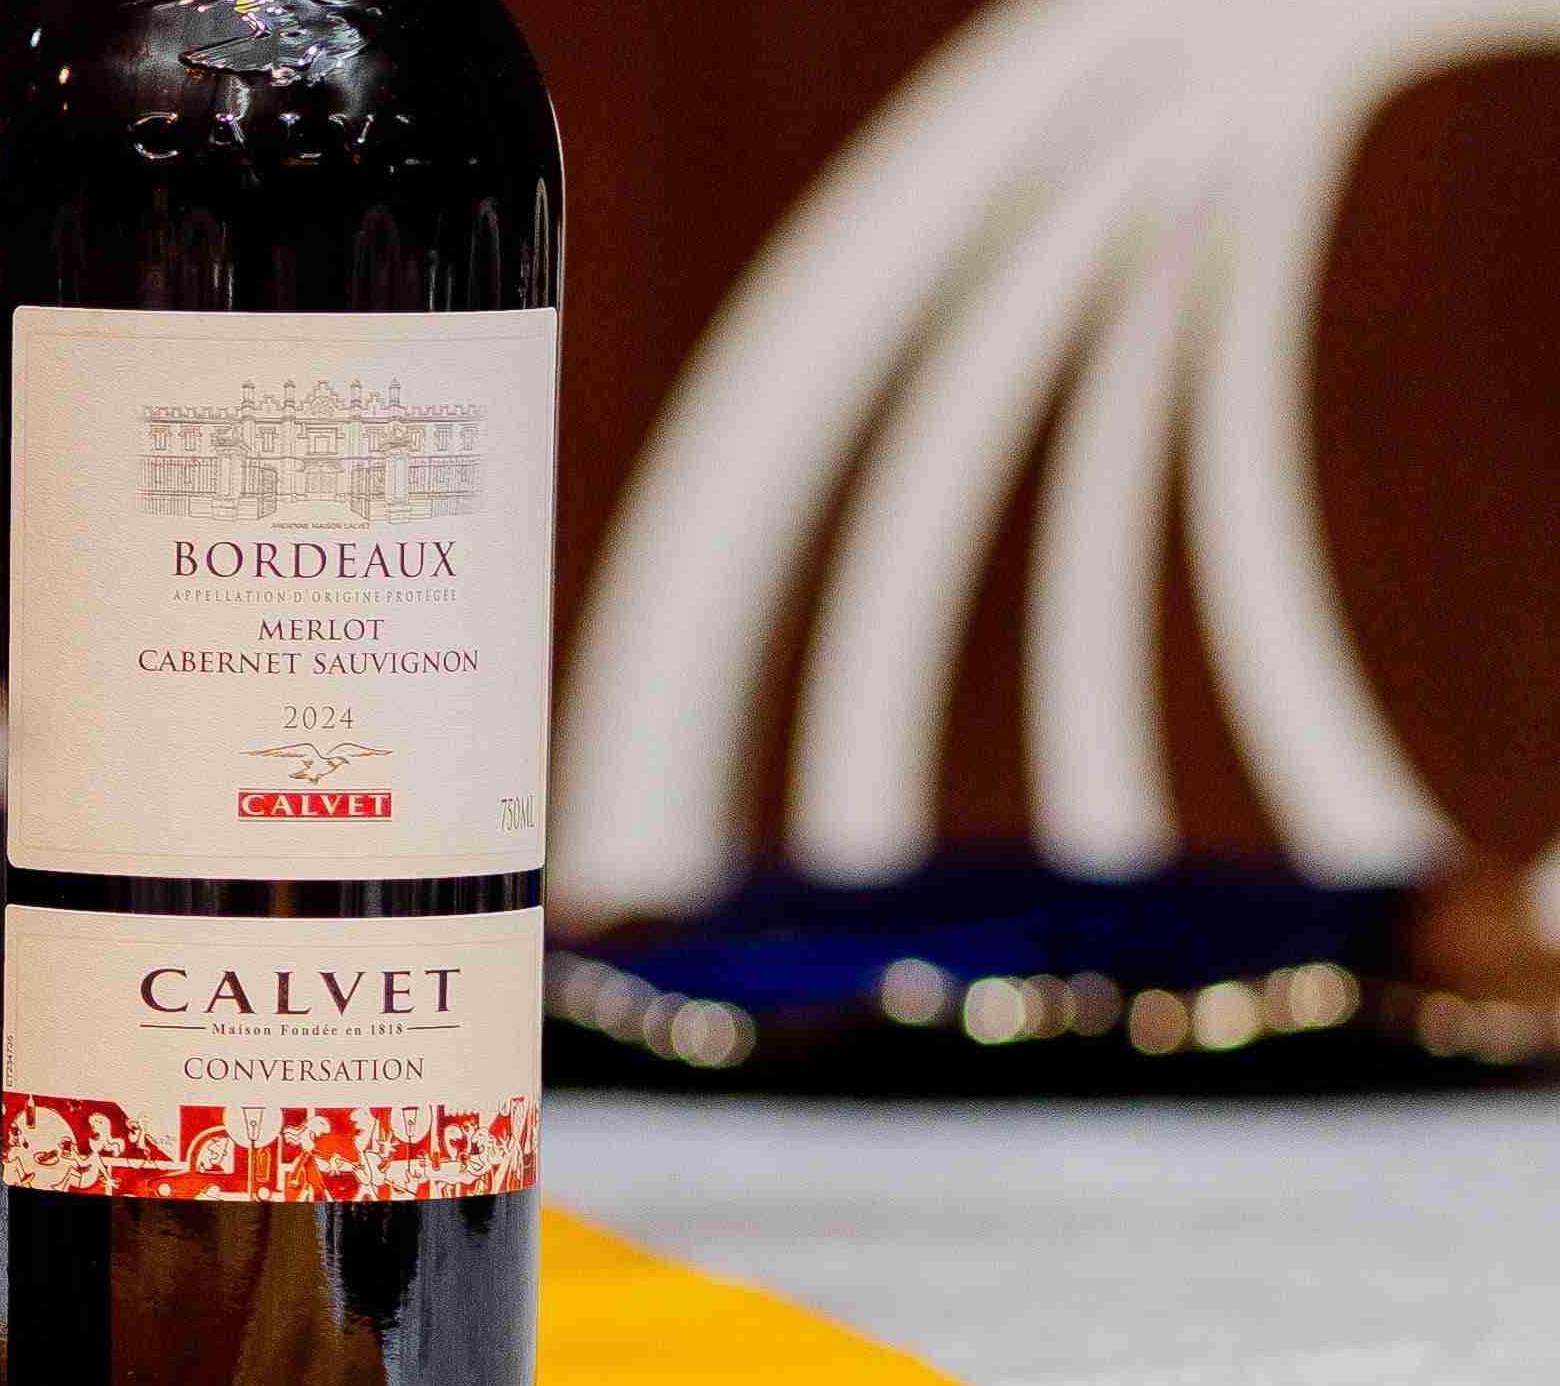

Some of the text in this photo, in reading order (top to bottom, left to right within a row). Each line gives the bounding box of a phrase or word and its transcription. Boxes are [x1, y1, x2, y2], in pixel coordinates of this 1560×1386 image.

[172, 540, 456, 579] BORDEAUX
[173, 588, 286, 602] APPELLATION
[293, 588, 380, 605] D'ORIGINE
[258, 619, 384, 641] MERLOT
[138, 649, 479, 675] CABERNET SAUVIGNON
[283, 705, 354, 730] 2024
[241, 794, 390, 816] CALVET
[140, 968, 461, 1015] CALVET
[212, 1022, 403, 1036] Maison Fondée en 1818
[184, 1057, 425, 1082] CONVERSATION
